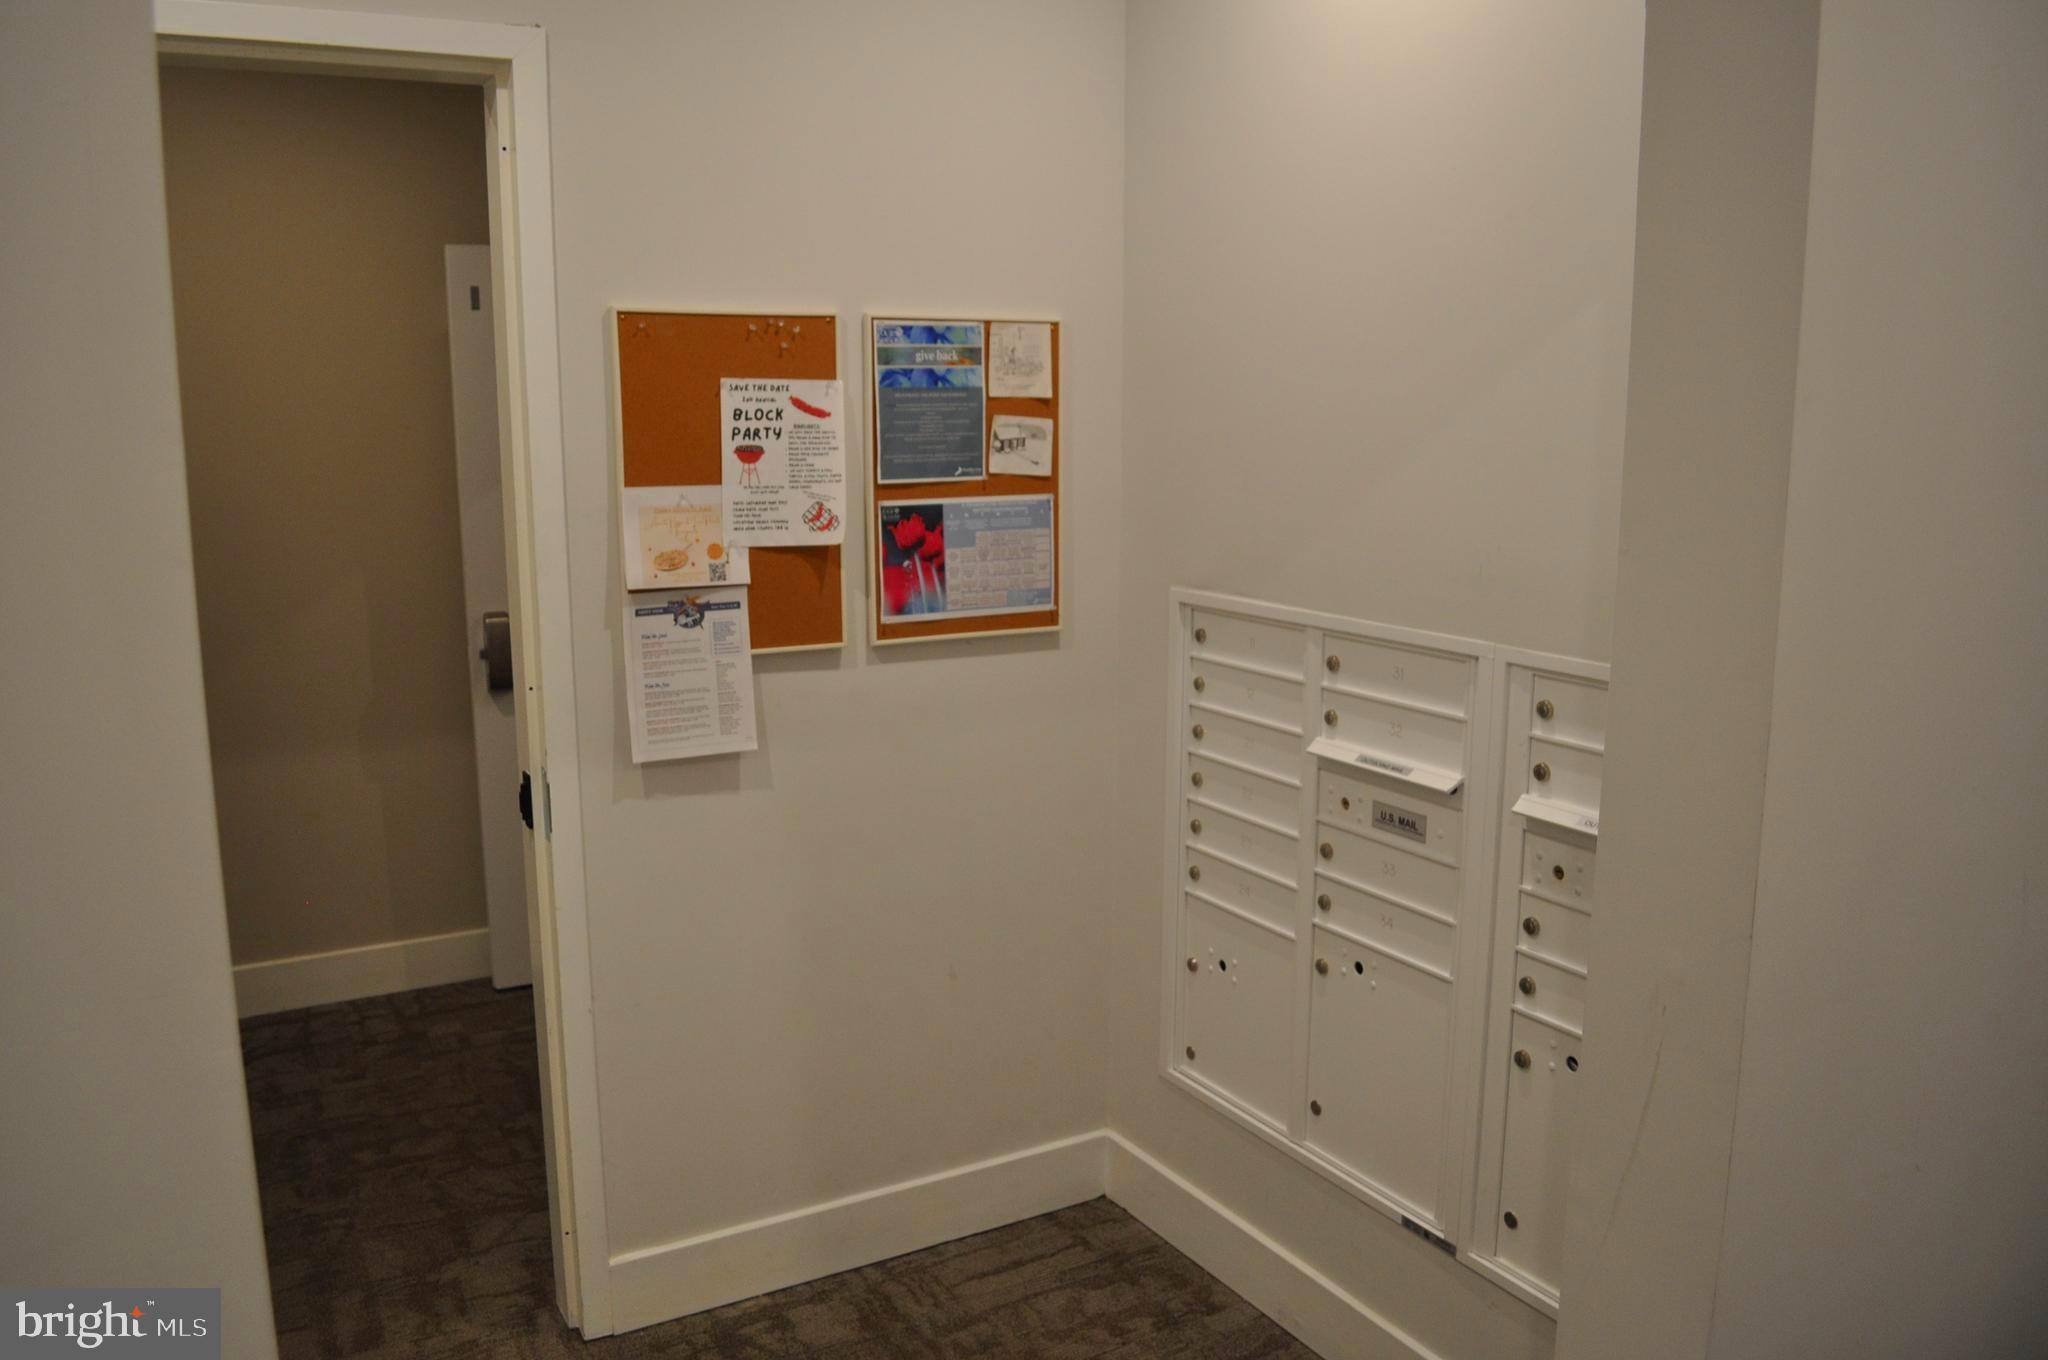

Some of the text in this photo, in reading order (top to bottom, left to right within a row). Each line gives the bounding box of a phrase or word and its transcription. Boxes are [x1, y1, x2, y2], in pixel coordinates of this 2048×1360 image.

[915, 349, 959, 363] give back
[729, 383, 790, 393] SAVE THE DATE
[733, 407, 784, 421] BLOCK
[731, 426, 782, 441] PARTY
[1392, 664, 1405, 681] 31
[1389, 719, 1403, 738] 32
[1398, 815, 1419, 831] MAIL
[1382, 860, 1397, 877] 33
[1379, 912, 1393, 930] 34
